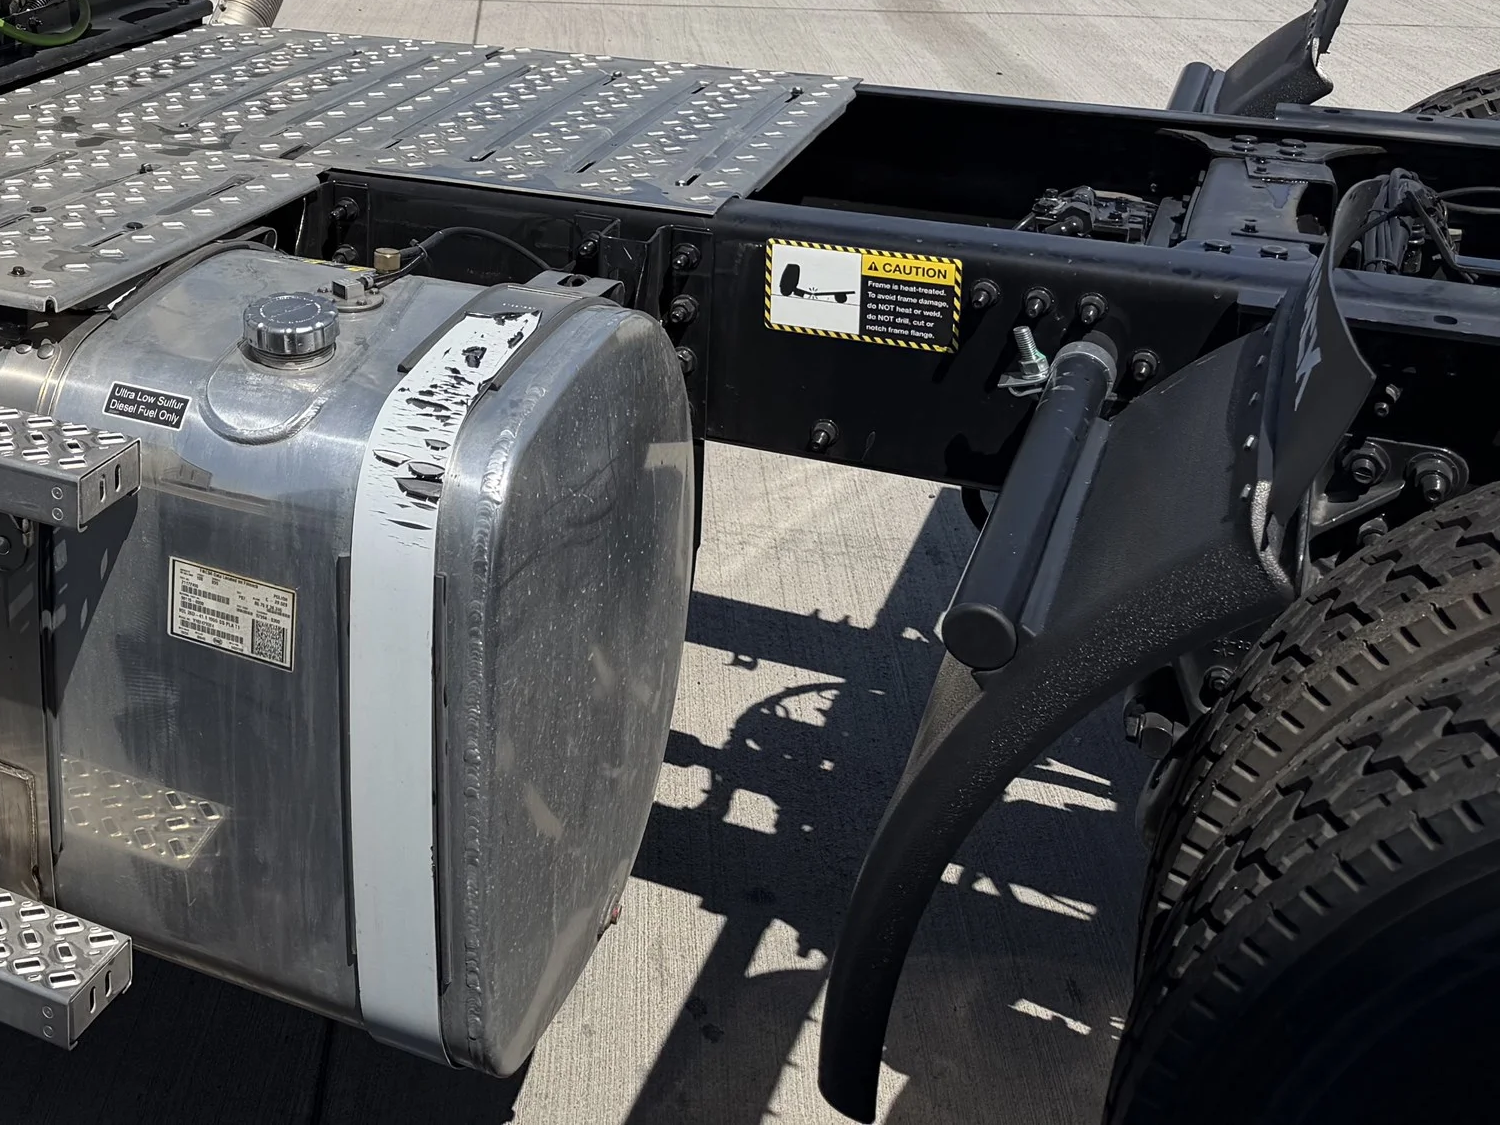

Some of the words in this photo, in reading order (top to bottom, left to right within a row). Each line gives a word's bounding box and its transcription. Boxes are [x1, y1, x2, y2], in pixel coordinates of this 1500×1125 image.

[882, 263, 947, 279] CAUTION
[867, 280, 891, 290] Frame
[899, 284, 947, 296] heat-treated.
[867, 291, 876, 299] To
[876, 293, 896, 302] avoid
[897, 295, 918, 304] frame
[918, 298, 949, 309] damage,
[878, 304, 895, 312] NOT
[895, 306, 912, 315] heat
[866, 313, 877, 321] do
[877, 315, 895, 323] NOT
[895, 317, 911, 326] drill,
[865, 325, 887, 333] notch
[887, 327, 910, 336] frame
[910, 330, 935, 340] flange.
[114, 386, 136, 400] Ultra
[136, 391, 157, 404] Low
[156, 396, 185, 410] Sulfur
[109, 398, 137, 414] Diesel
[137, 404, 158, 419] Fuel
[158, 410, 180, 425] Only
